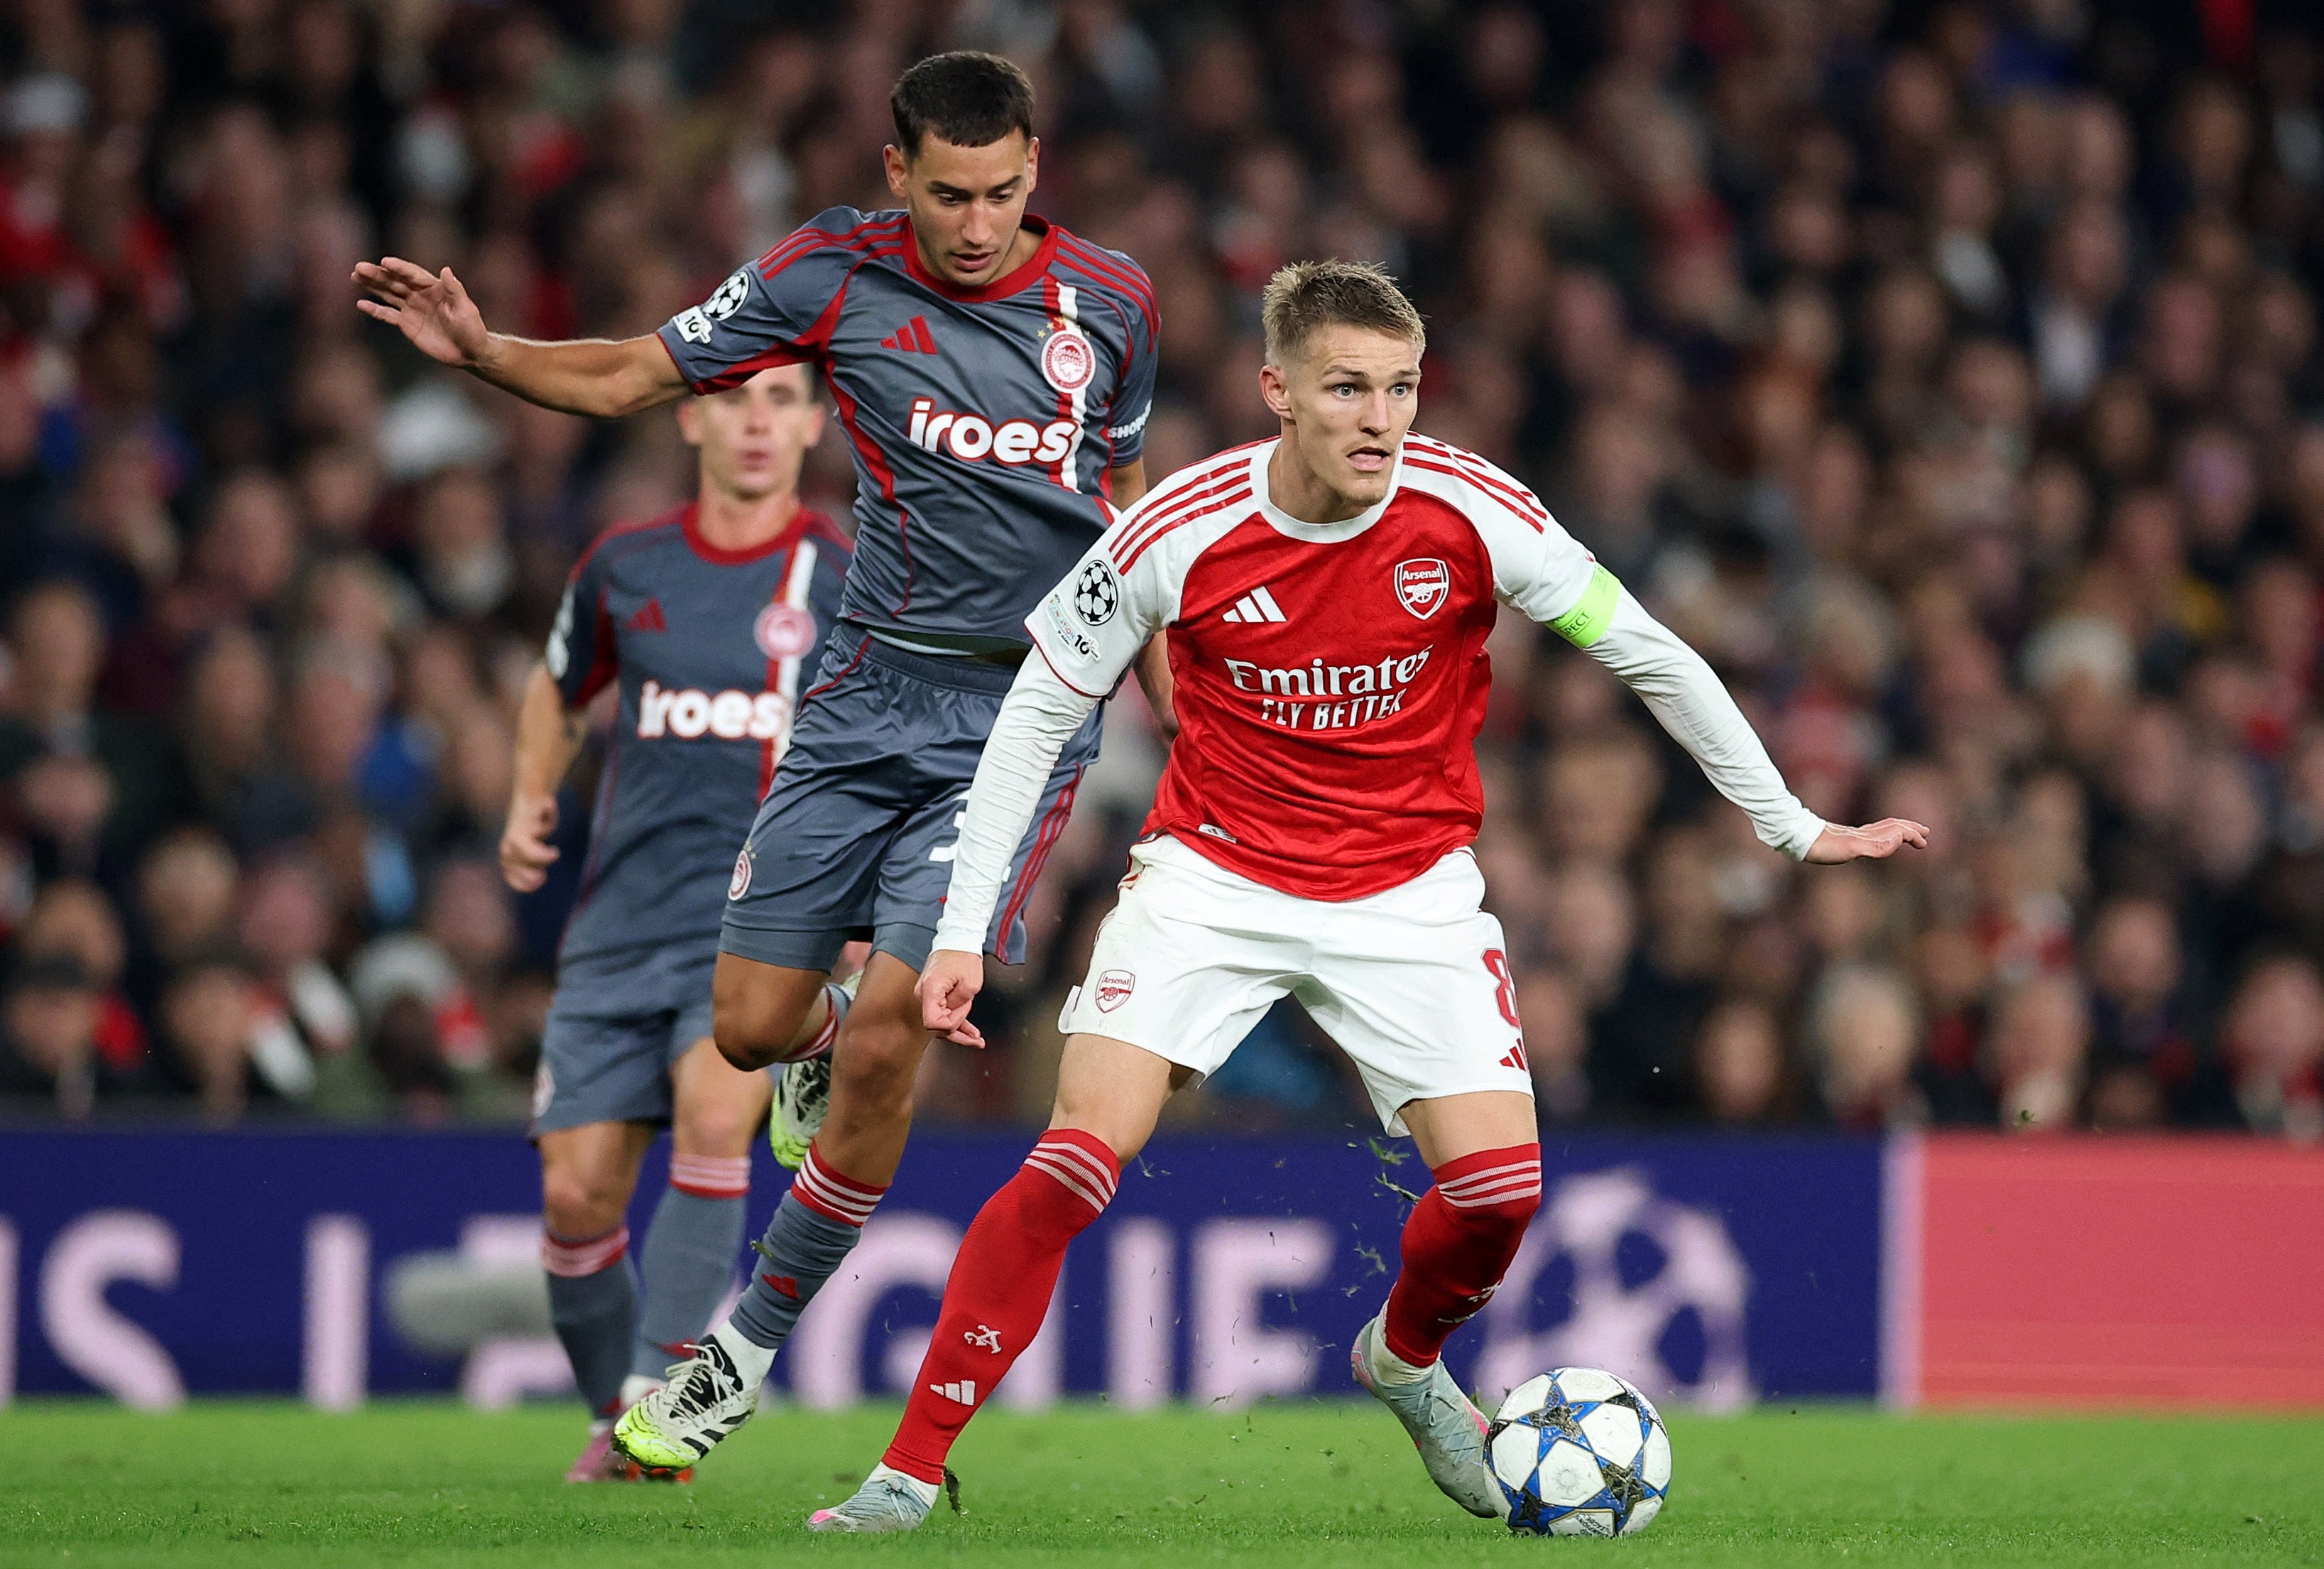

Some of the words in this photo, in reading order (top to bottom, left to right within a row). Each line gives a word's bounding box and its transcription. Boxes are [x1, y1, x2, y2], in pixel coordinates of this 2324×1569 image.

[909, 399, 1079, 464] iroes
[1402, 568, 1441, 581] Arsenal
[1224, 644, 1434, 697] Emirates
[639, 678, 790, 739] iroes
[1261, 697, 1305, 729] FLY
[1312, 688, 1407, 730] BETTER
[1103, 977, 1130, 986] Arsenal
[1480, 948, 1521, 1030] 8
